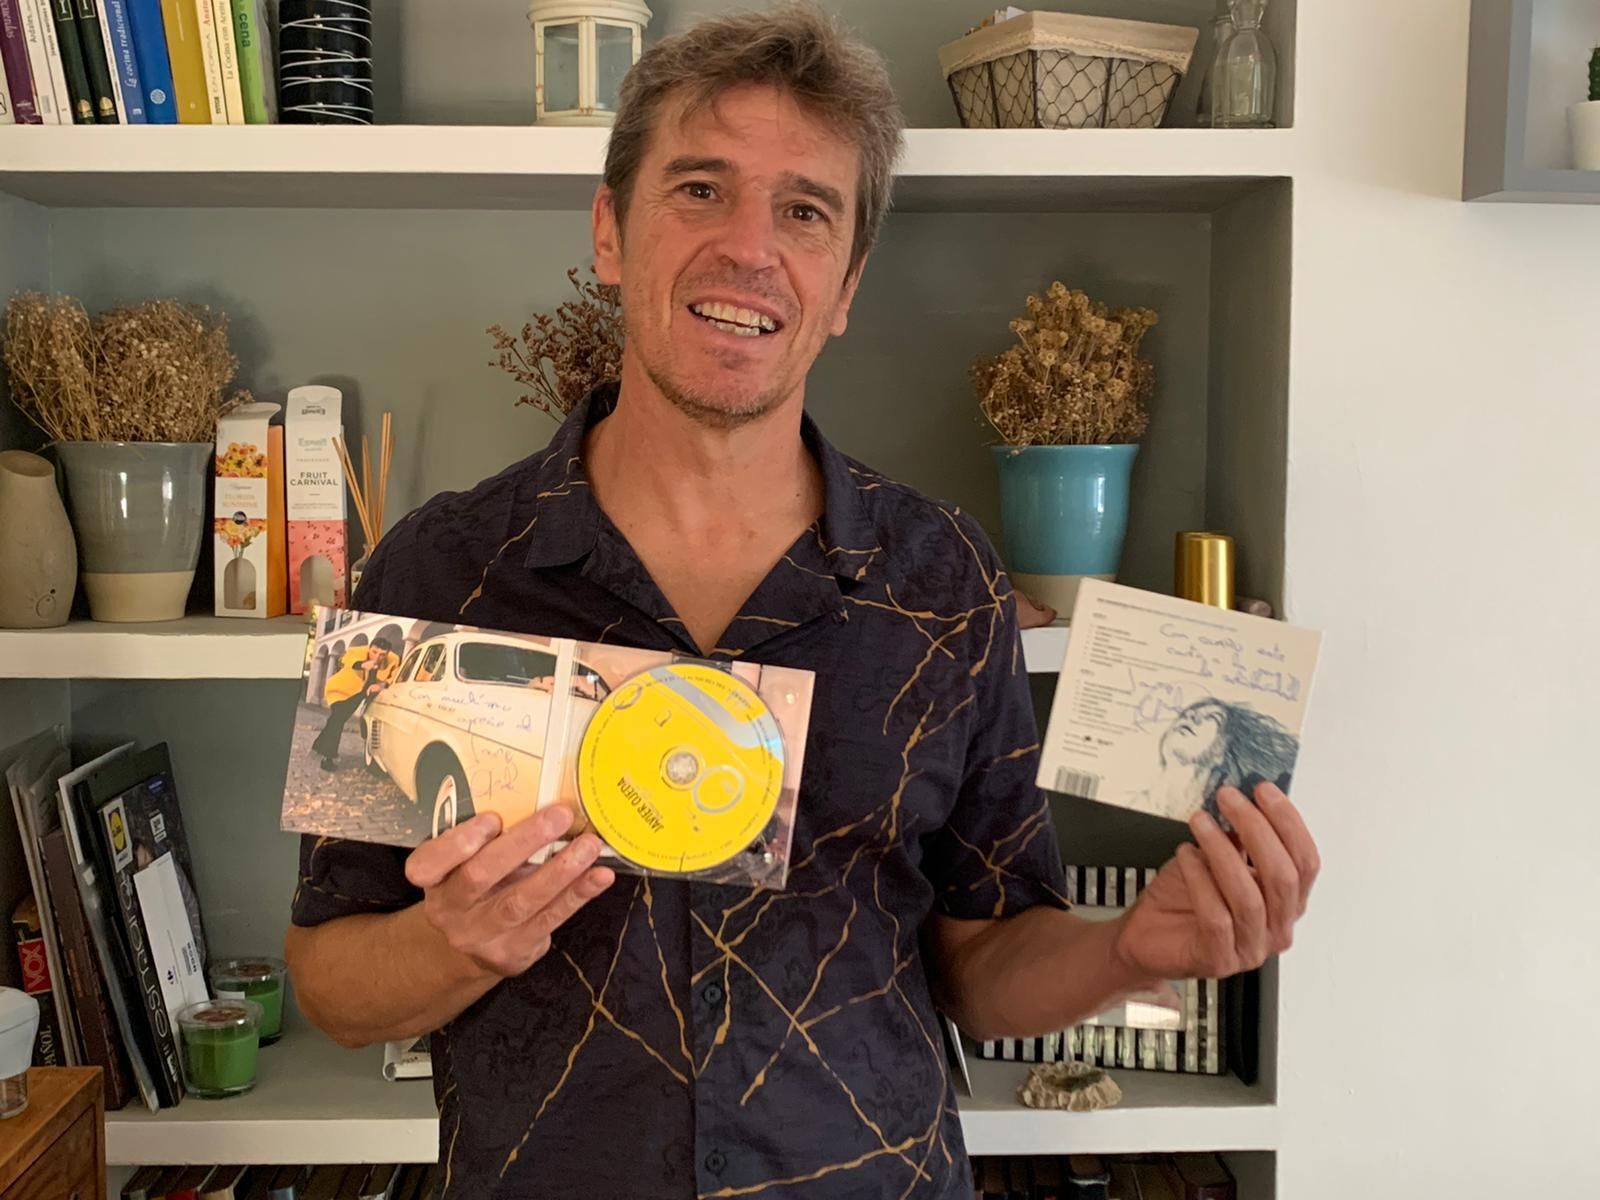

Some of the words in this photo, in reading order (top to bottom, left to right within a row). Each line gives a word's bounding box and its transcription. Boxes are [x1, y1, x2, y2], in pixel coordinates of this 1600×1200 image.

[111, 0, 128, 47] tradicional
[239, 13, 251, 48] cena
[122, 49, 134, 76] cocina
[224, 43, 233, 69] Cocina
[617, 776, 642, 806] OJEDA
[637, 803, 664, 832] JAVIER
[22, 944, 46, 989] VOX
